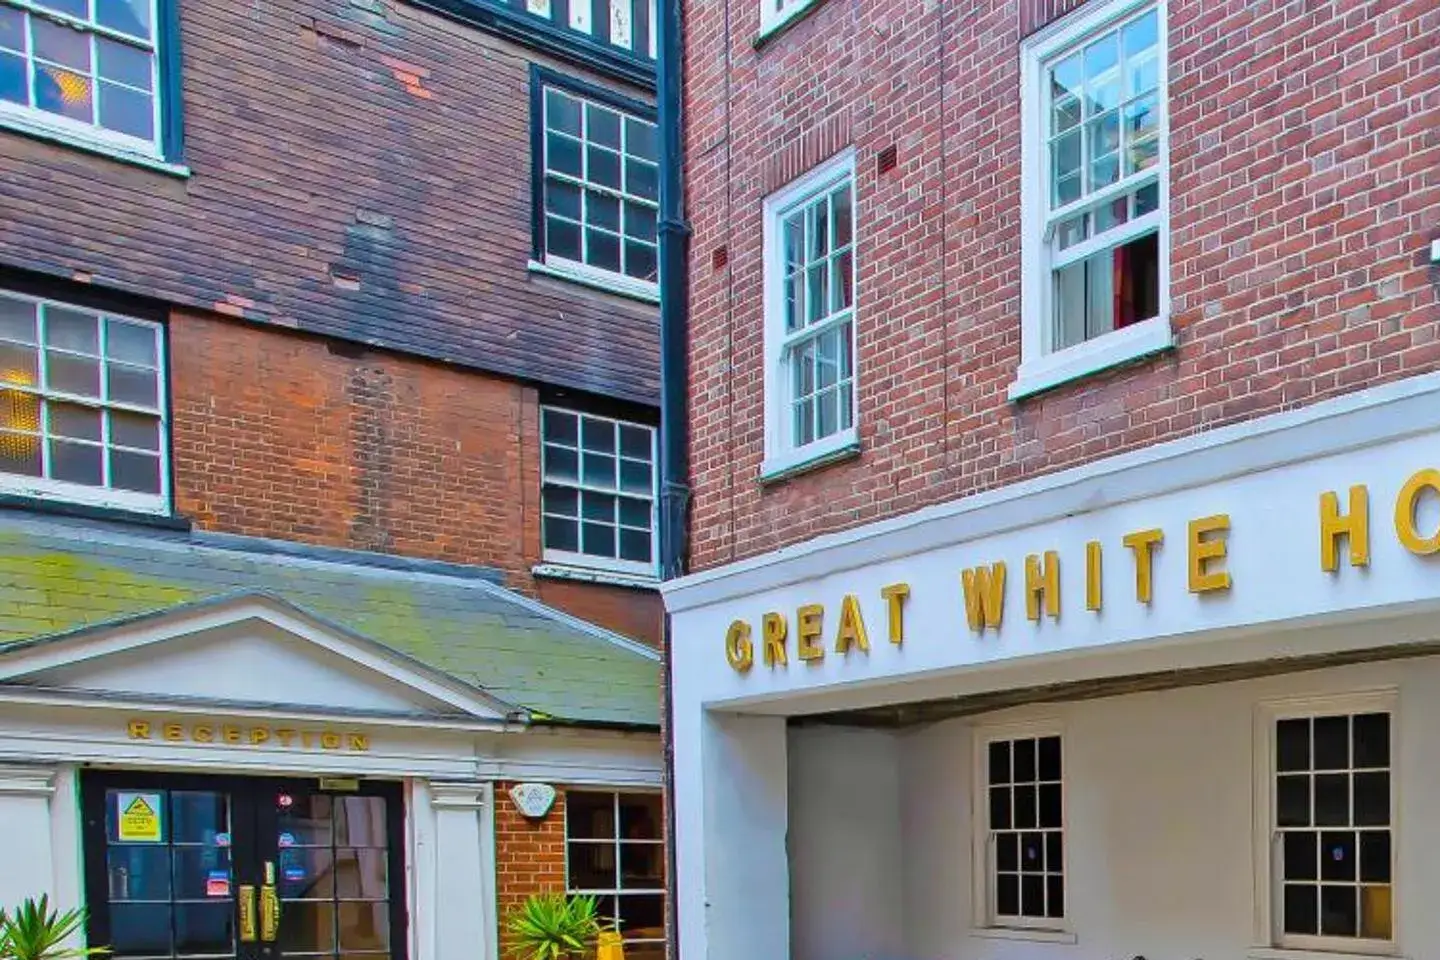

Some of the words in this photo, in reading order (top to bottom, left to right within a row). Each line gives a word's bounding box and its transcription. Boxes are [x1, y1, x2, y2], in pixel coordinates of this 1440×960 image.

[725, 583, 910, 673] GREAT
[960, 513, 1231, 634] WHITE
[128, 720, 369, 751] RECEPTION
